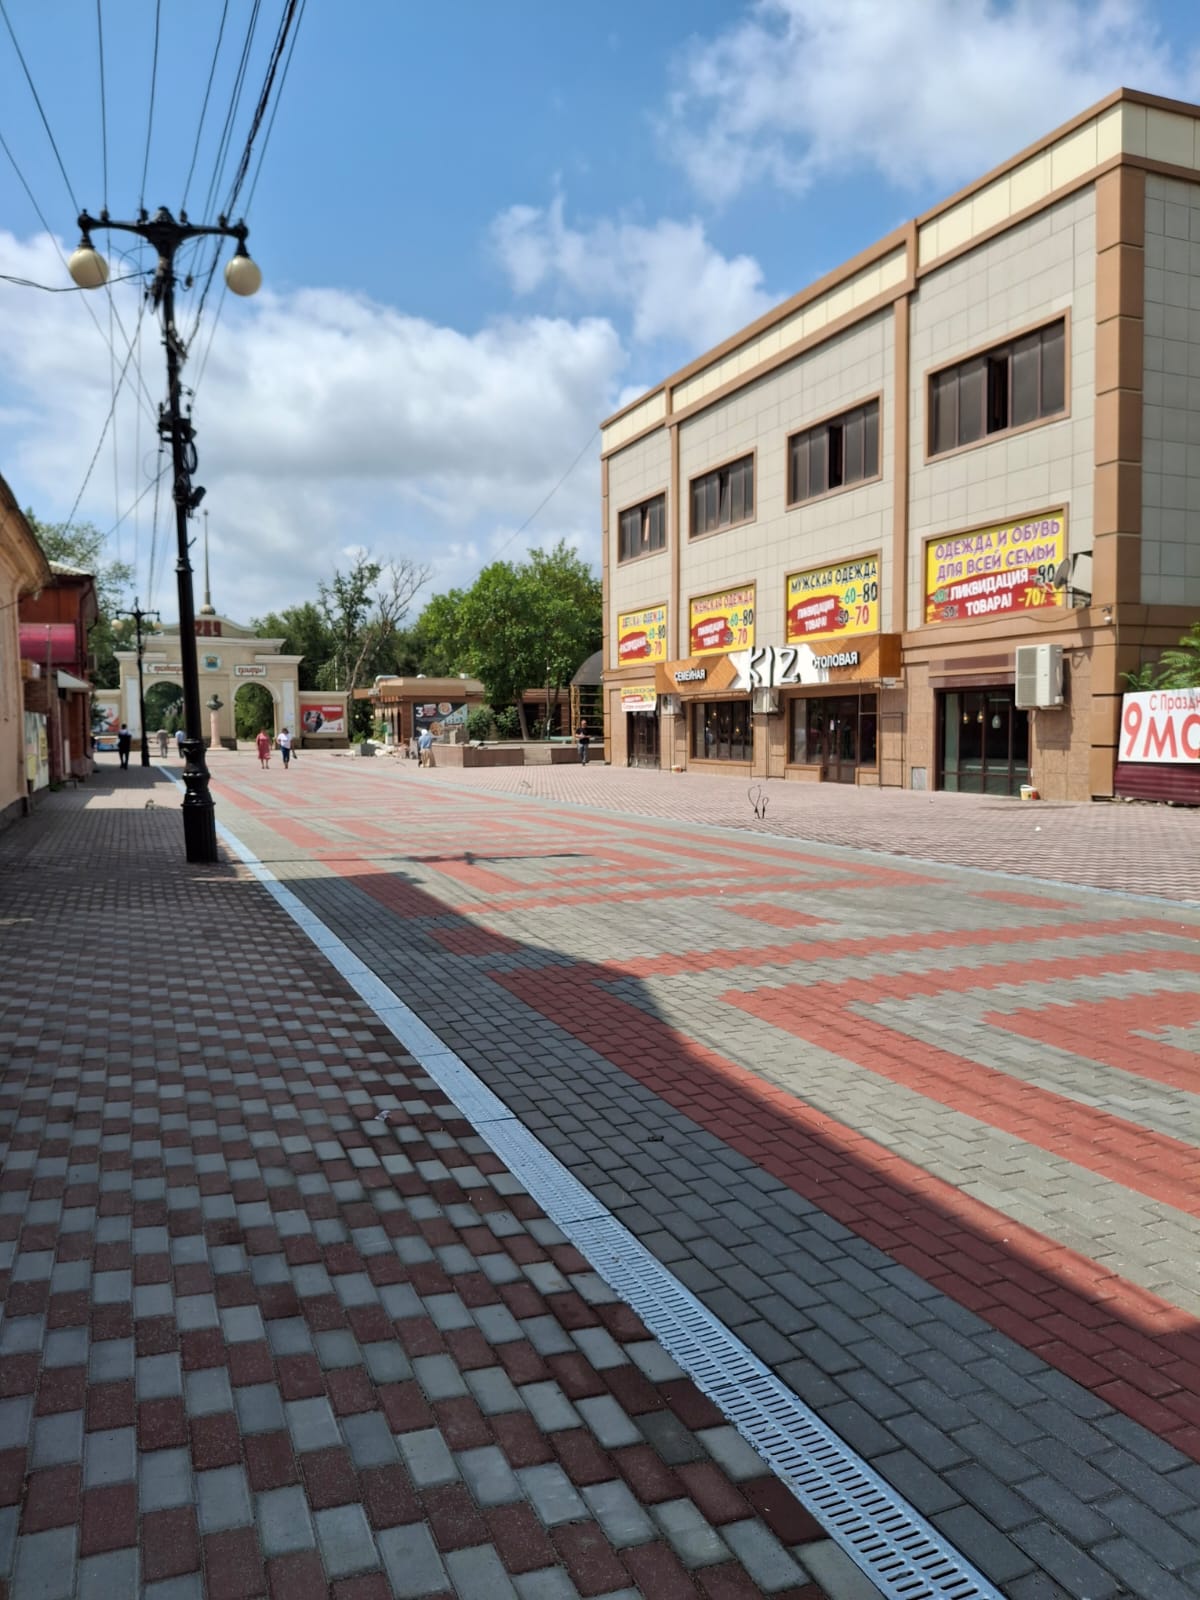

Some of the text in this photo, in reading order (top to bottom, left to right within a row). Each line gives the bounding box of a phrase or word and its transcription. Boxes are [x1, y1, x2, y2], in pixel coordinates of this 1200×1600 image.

[935, 519, 1060, 560] ОДЕЖДА И ОБУВЬ
[936, 543, 1055, 583] ДЛЯ ВСЕЙ СЕМЬИ
[791, 561, 877, 592] МУЖСКАЯ ОДЕЖДА
[950, 568, 1028, 601] ЛИКВИДАЦИЯ
[724, 590, 752, 608] ОДЕЖДА
[965, 592, 1012, 616] ТОВАРА!
[811, 651, 859, 669] СТОЛОВАЯ
[674, 667, 707, 681] СЕМЕЙНАЯ
[1149, 694, 1157, 711] С
